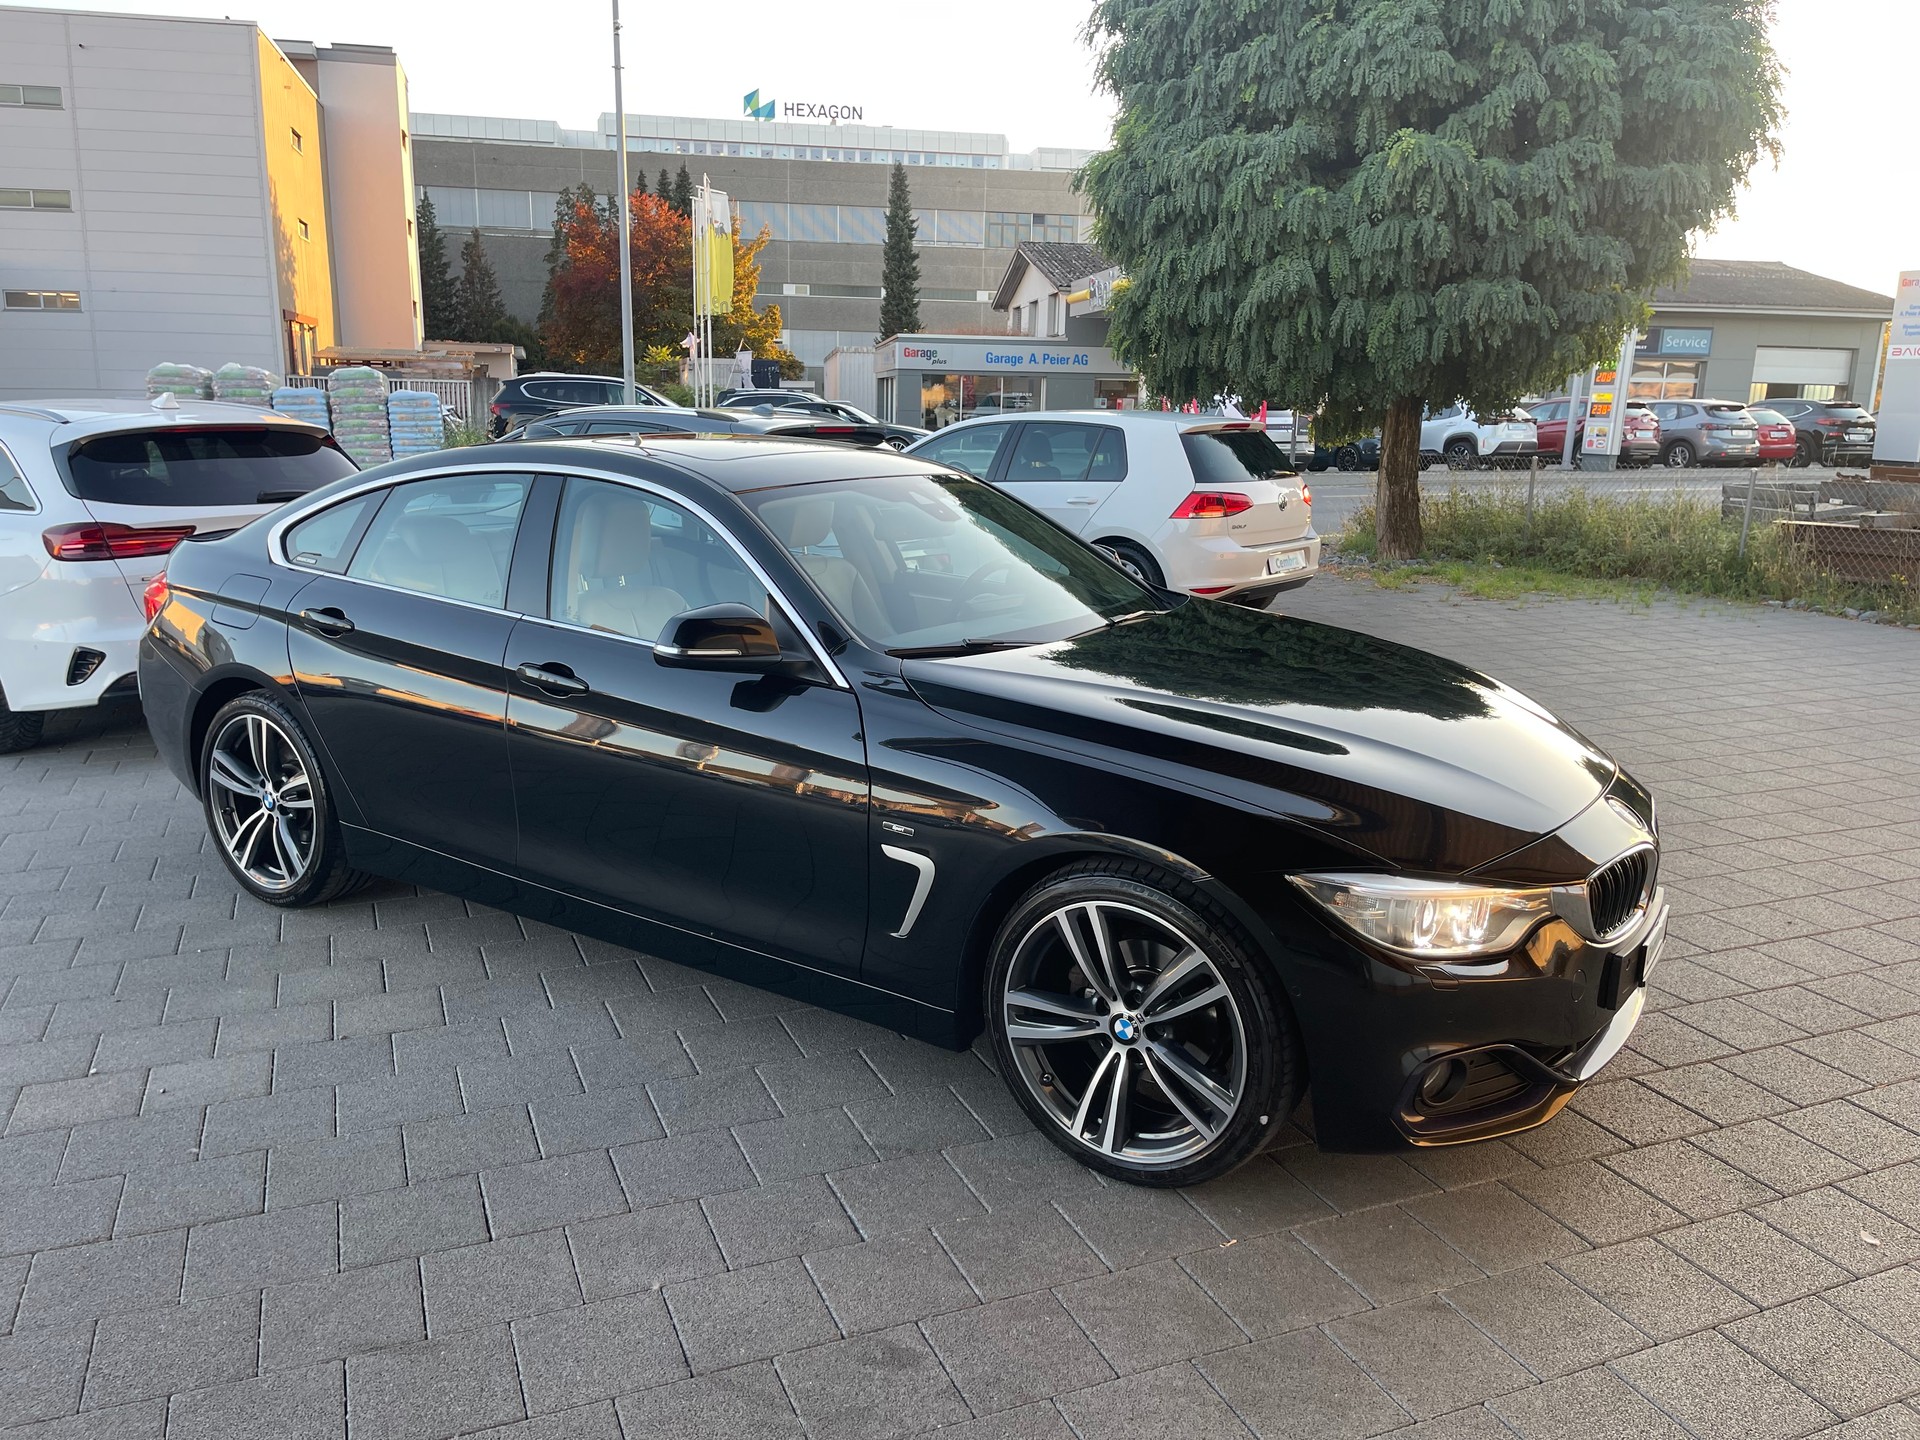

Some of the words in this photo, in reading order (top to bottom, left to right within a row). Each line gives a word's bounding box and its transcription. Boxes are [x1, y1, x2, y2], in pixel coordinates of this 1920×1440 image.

[784, 102, 863, 120] HEXAGON
[1665, 335, 1708, 348] Service
[903, 347, 938, 361] Garage
[985, 352, 1024, 367] Garage
[1028, 353, 1039, 365] A.
[1042, 353, 1071, 366] Peier
[1072, 354, 1089, 366] AG
[931, 358, 947, 366] plus
